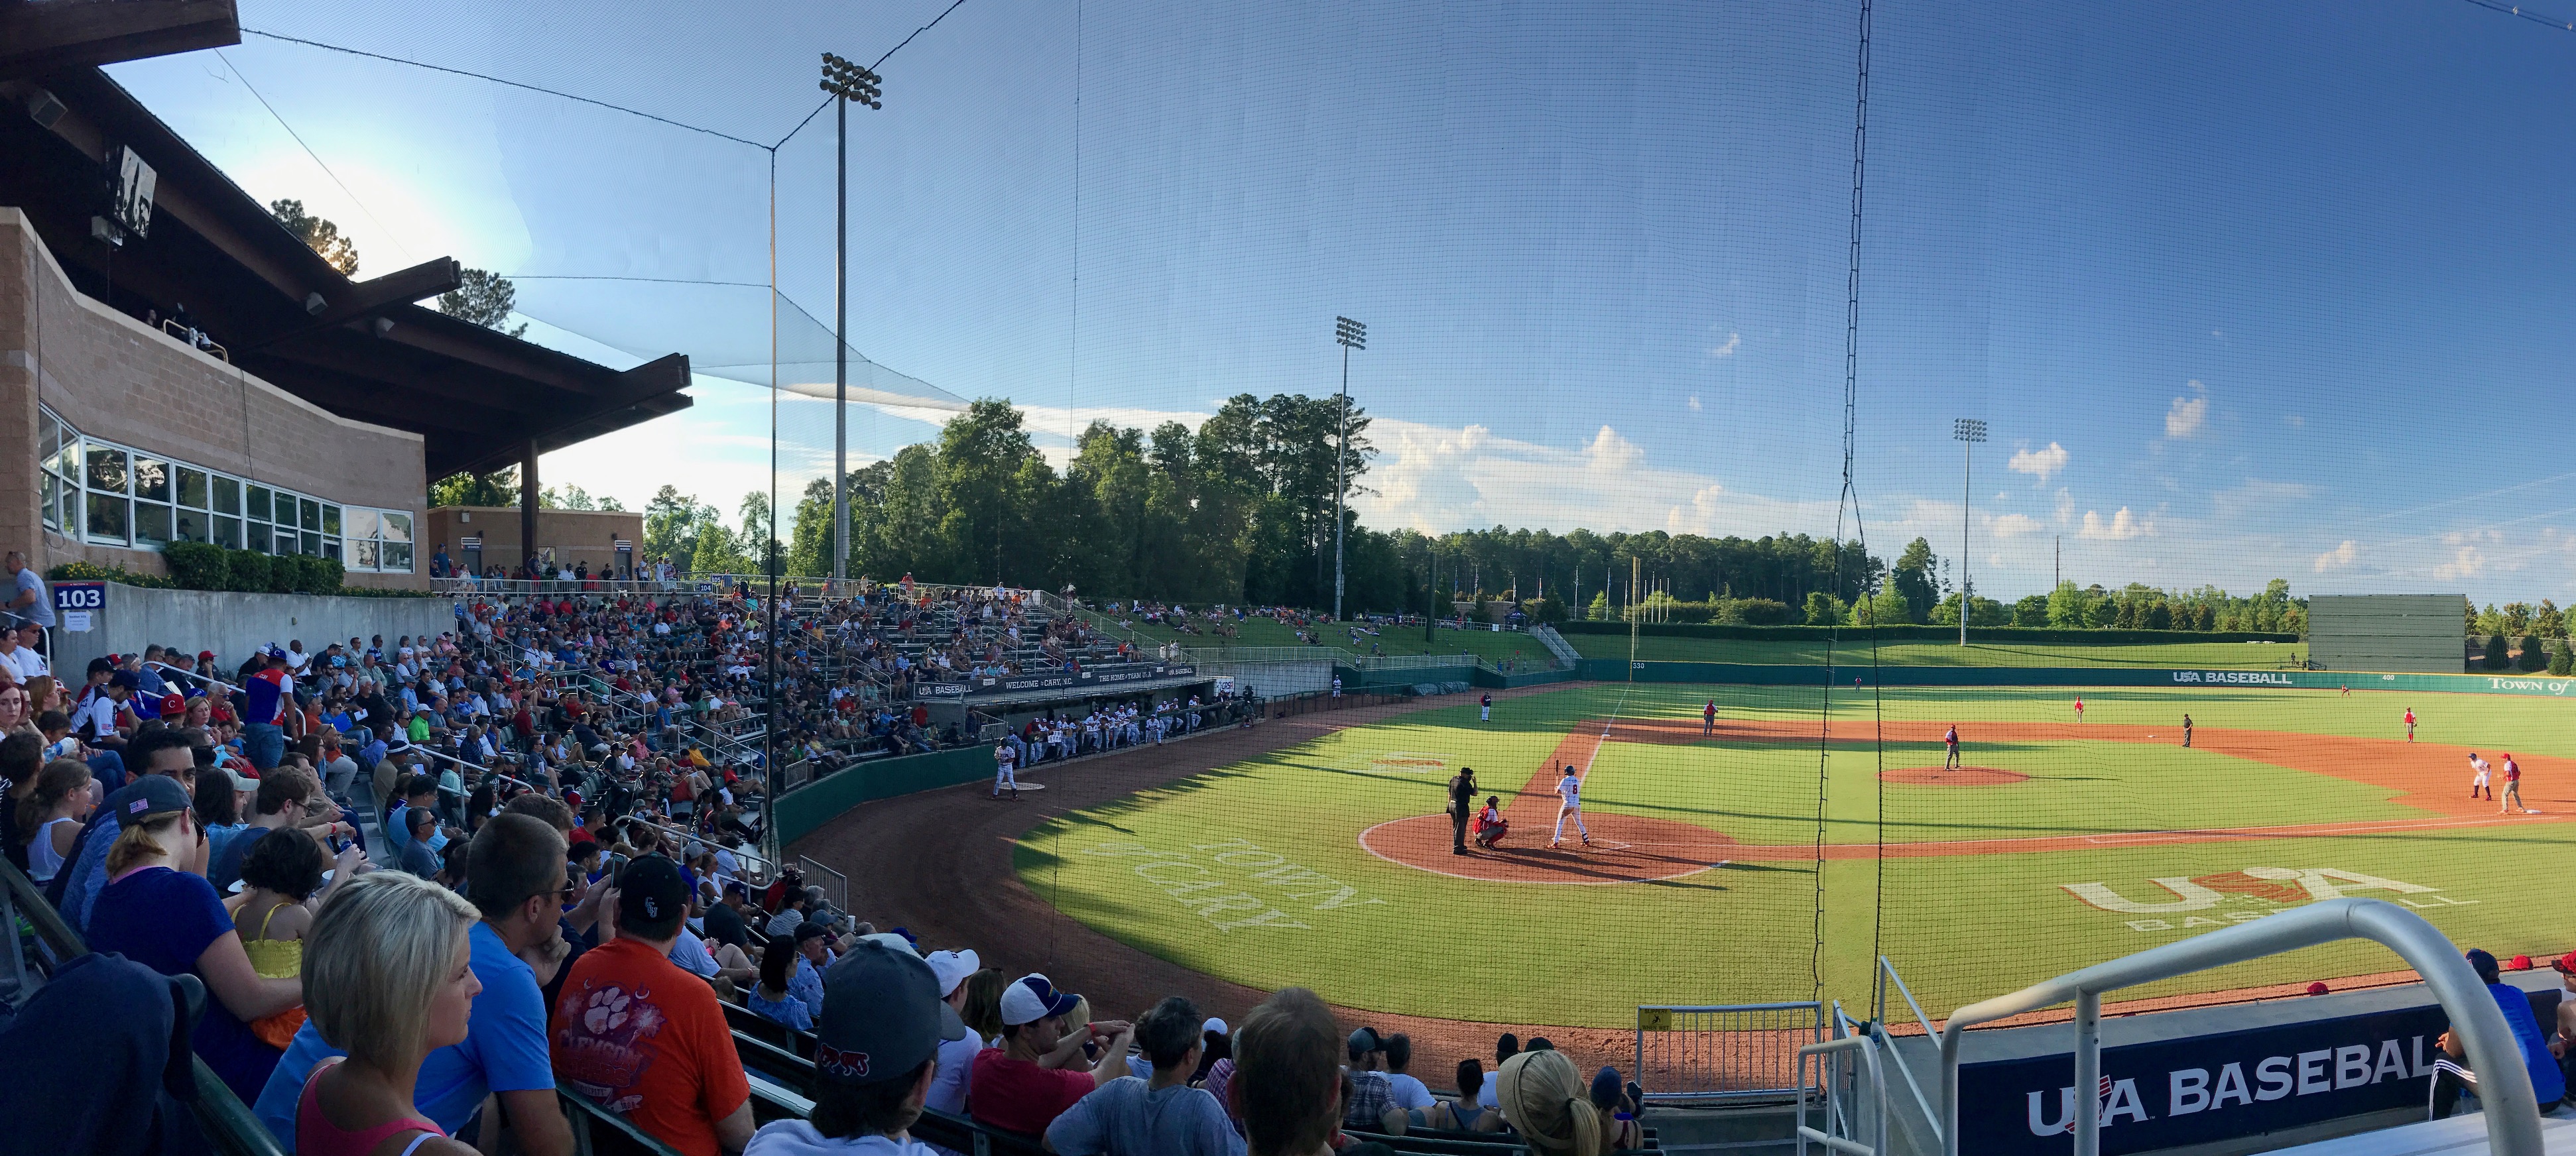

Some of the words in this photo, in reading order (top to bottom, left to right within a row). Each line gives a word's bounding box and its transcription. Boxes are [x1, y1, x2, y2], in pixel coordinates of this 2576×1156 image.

[58, 589, 101, 608] 103
[1005, 680, 1039, 689] WELCOME
[2173, 671, 2203, 683] USA
[2205, 672, 2293, 685] BASEBALL
[2488, 677, 2544, 691] TOWN
[2547, 679, 2574, 695] of
[919, 685, 932, 696] USA
[935, 685, 973, 695] BASEBALL
[1572, 784, 1577, 795] 8
[1189, 837, 1387, 911] TOWN
[2058, 867, 2445, 914] USA
[2124, 896, 2481, 932] BASLL
[558, 1029, 644, 1074] CLEMSON
[2168, 1035, 2434, 1118] BASEBAL
